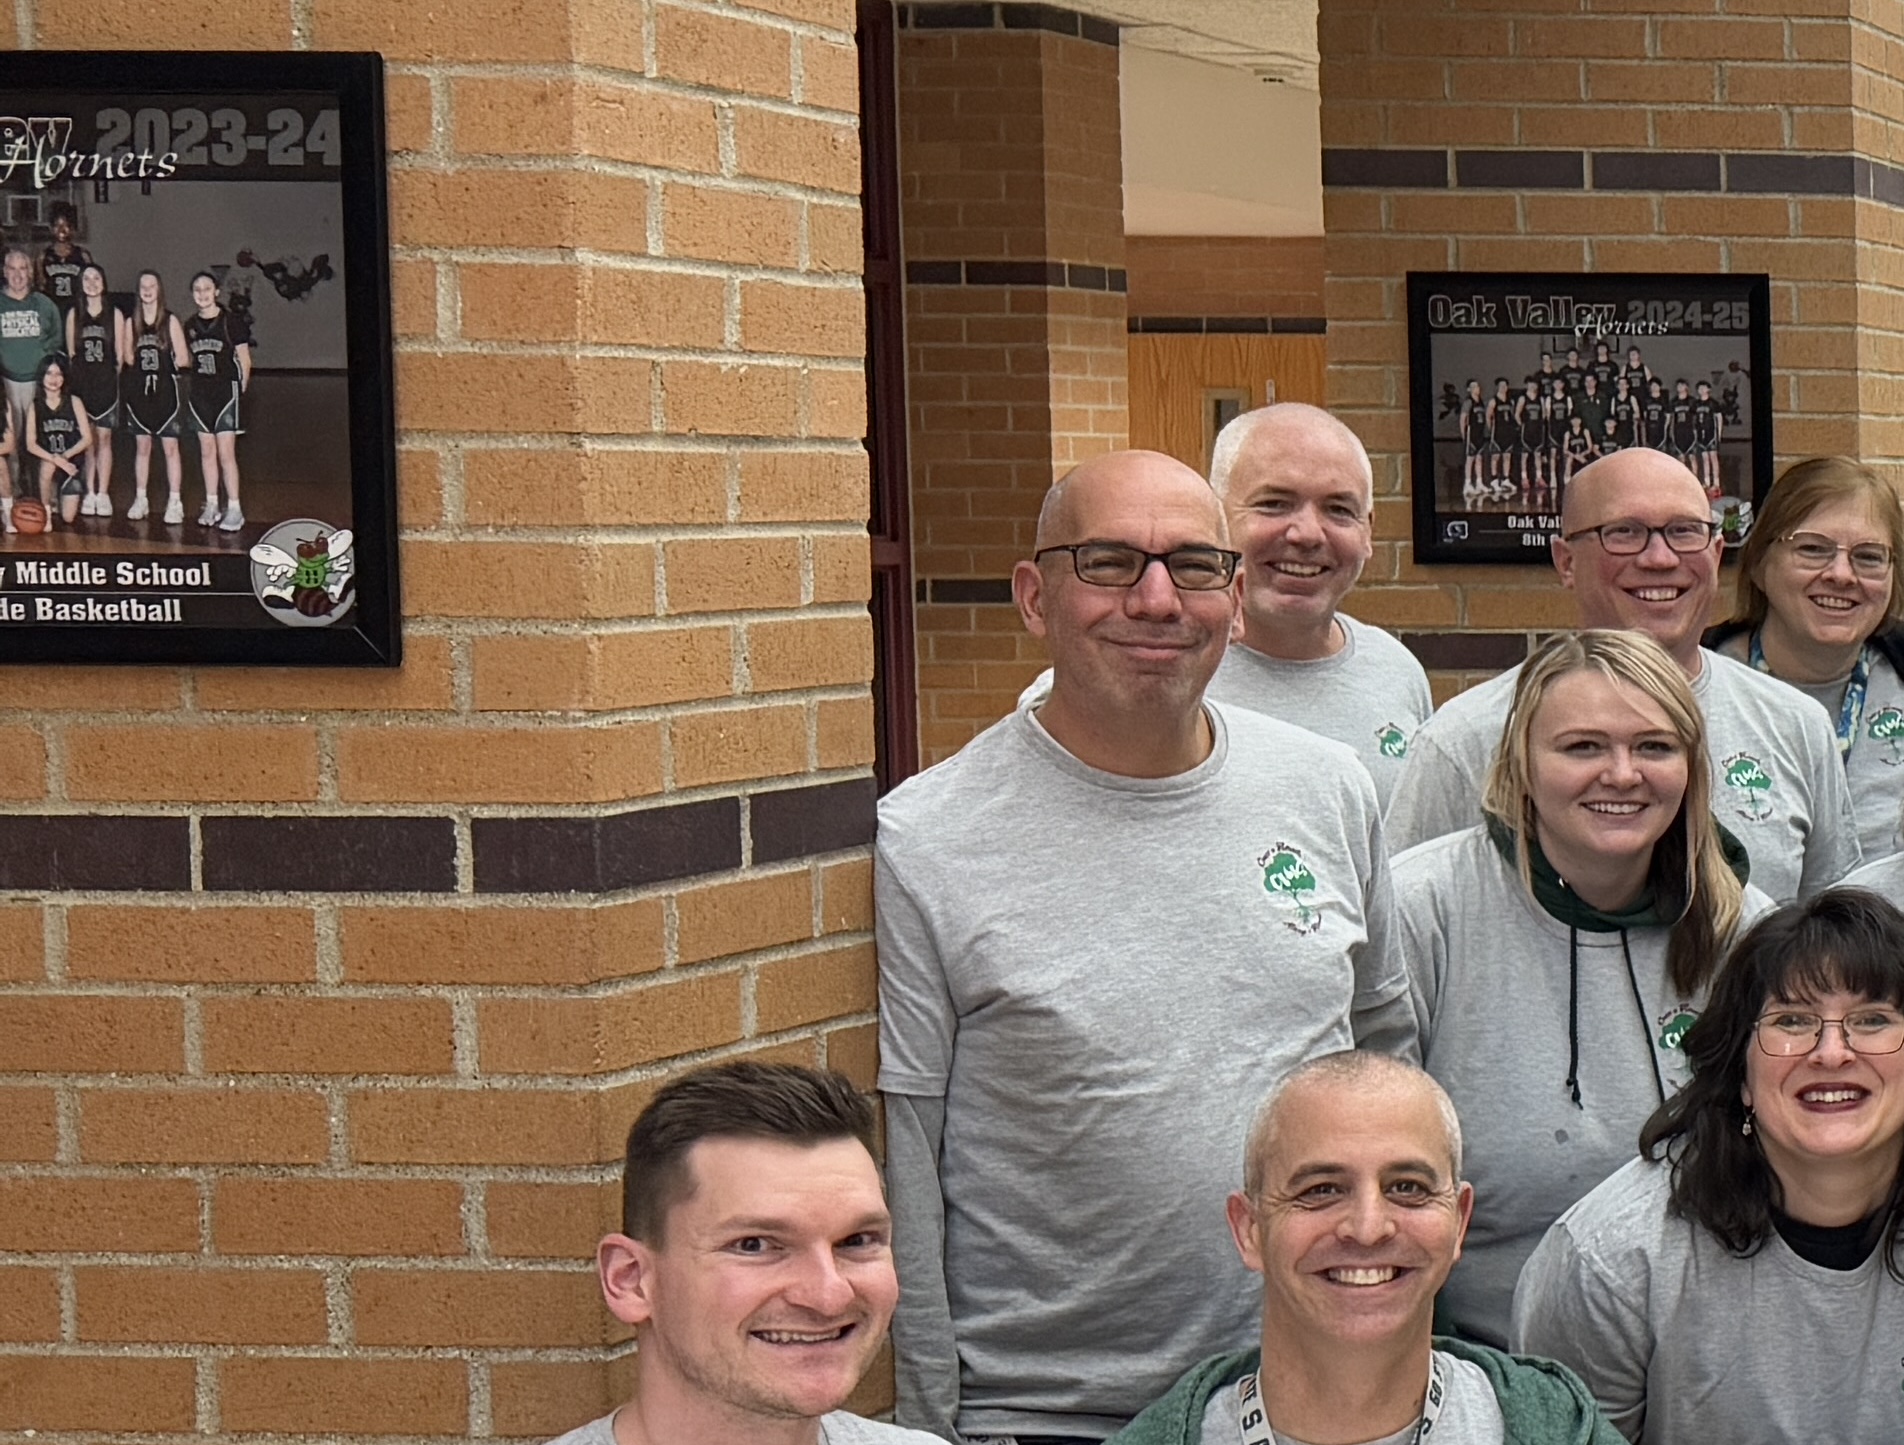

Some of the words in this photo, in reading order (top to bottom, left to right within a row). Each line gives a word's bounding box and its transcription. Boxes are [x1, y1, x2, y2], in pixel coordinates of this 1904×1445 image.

[96, 107, 342, 166] 2023-24
[0, 135, 178, 189] Hornets
[1428, 295, 1497, 328] Oak
[1505, 295, 1616, 329] Valley
[1628, 300, 1750, 330] 2024-25
[1574, 311, 1670, 340] Hornets
[1508, 515, 1534, 529] Oak
[1522, 533, 1546, 546] 8th
[15, 562, 107, 586] Middle
[116, 563, 212, 587] School
[35, 598, 182, 622] Basketball
